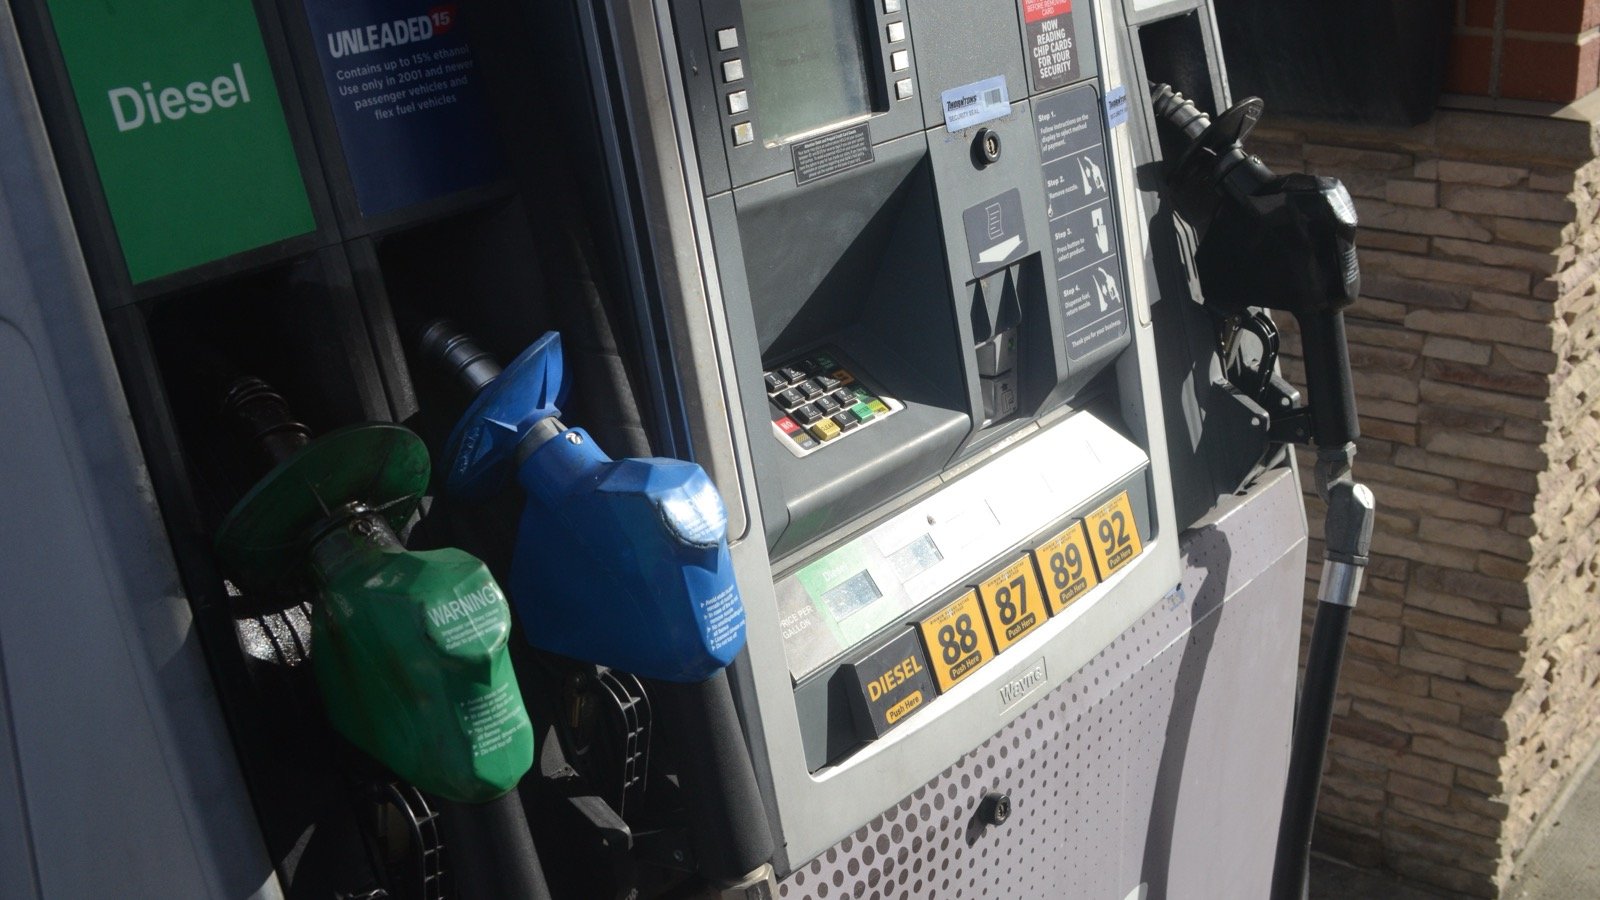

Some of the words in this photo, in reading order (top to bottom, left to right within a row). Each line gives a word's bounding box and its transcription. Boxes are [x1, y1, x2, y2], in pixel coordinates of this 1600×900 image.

[328, 15, 433, 58] UNLEADED
[432, 11, 450, 27] 15
[1036, 28, 1066, 45] READING
[1041, 18, 1058, 33] NOW
[1033, 44, 1050, 58] CHIP
[1050, 37, 1072, 53] CARDS
[1038, 54, 1052, 68] FOR
[1052, 49, 1070, 64] YOUR
[336, 62, 382, 81] Contains
[384, 60, 397, 73] up
[399, 56, 411, 68] to
[412, 52, 432, 64] 15%
[433, 44, 470, 60] ethanol
[1039, 60, 1071, 79] SECURITY
[338, 84, 359, 97] Use
[362, 79, 383, 93] only
[386, 76, 396, 87] in
[399, 70, 423, 84] 2001
[425, 64, 443, 78] and
[445, 60, 473, 75] newer
[108, 62, 250, 132] Diesel
[354, 90, 407, 111] passenger
[409, 80, 448, 96] vehicles
[450, 76, 468, 89] and
[374, 109, 394, 121] flex
[396, 101, 416, 115] fuel
[417, 94, 457, 111] vehicles
[1037, 113, 1050, 122] Step
[1047, 178, 1059, 188] Step
[1059, 175, 1065, 183] 2.
[1054, 231, 1066, 240] Step
[1063, 288, 1075, 297] Step
[1098, 510, 1131, 556] 92
[1049, 543, 1083, 589] 89
[1109, 553, 1121, 567] Push
[1120, 547, 1131, 559] Here
[995, 574, 1027, 626] 87
[1061, 587, 1075, 601] Push
[1074, 581, 1086, 593] Here
[781, 611, 799, 628] RICE
[797, 605, 813, 619] PER
[1008, 625, 1021, 639] Push
[1021, 616, 1034, 630] Here
[782, 618, 812, 639] GALLON
[938, 613, 978, 666] 88
[952, 664, 966, 677] Push
[966, 655, 980, 668] Here
[867, 655, 923, 702] DIESEL
[1000, 665, 1043, 705] Wayne
[889, 704, 904, 720] Push
[904, 696, 919, 710] Here
